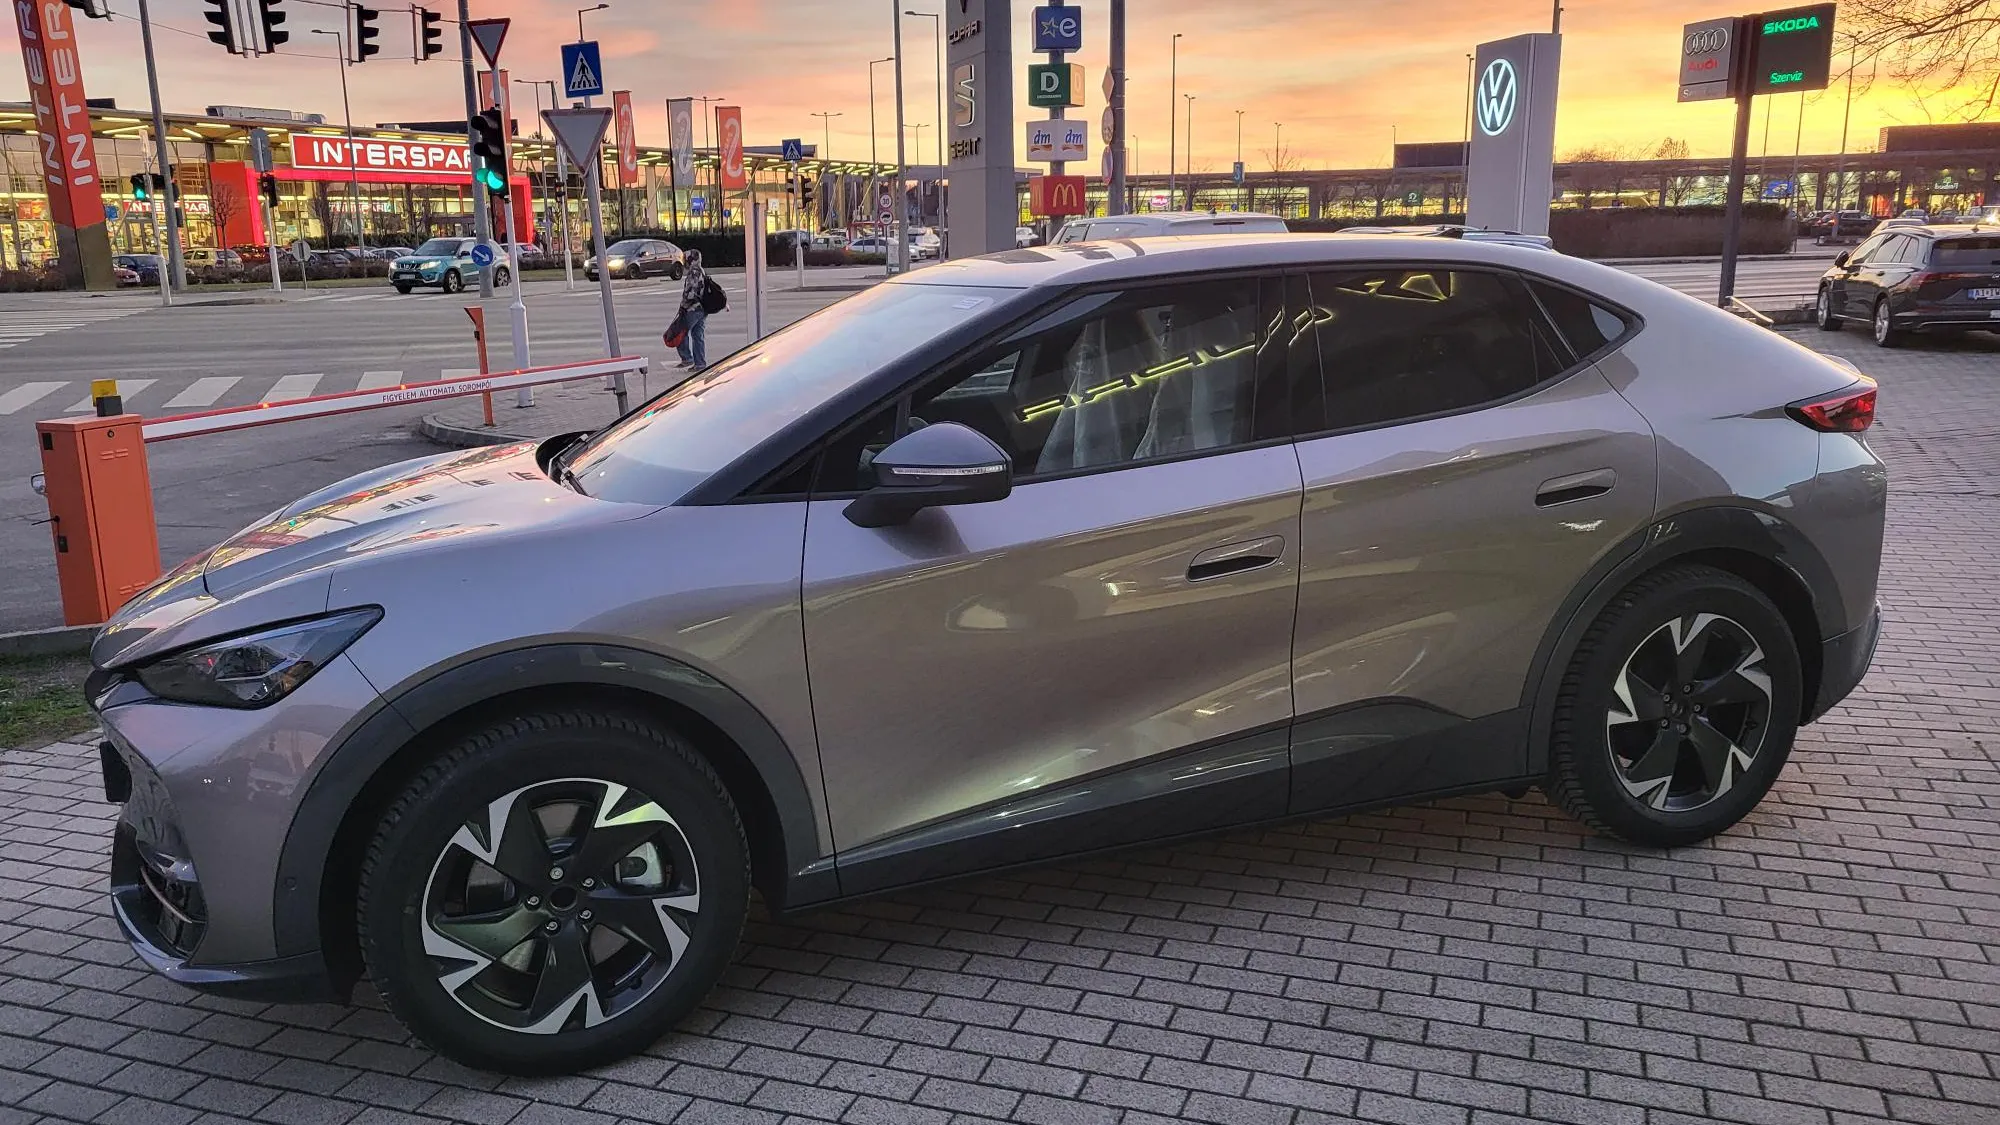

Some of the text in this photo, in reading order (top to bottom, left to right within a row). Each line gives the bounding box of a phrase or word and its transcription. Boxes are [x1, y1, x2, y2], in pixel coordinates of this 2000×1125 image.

[1770, 70, 1804, 84] Szerviz
[44, 1, 94, 186] INTER
[1033, 129, 1051, 144] dm
[1065, 129, 1082, 144] dm
[382, 391, 417, 403] FIGYELEM
[419, 386, 456, 398] AUTOMATA
